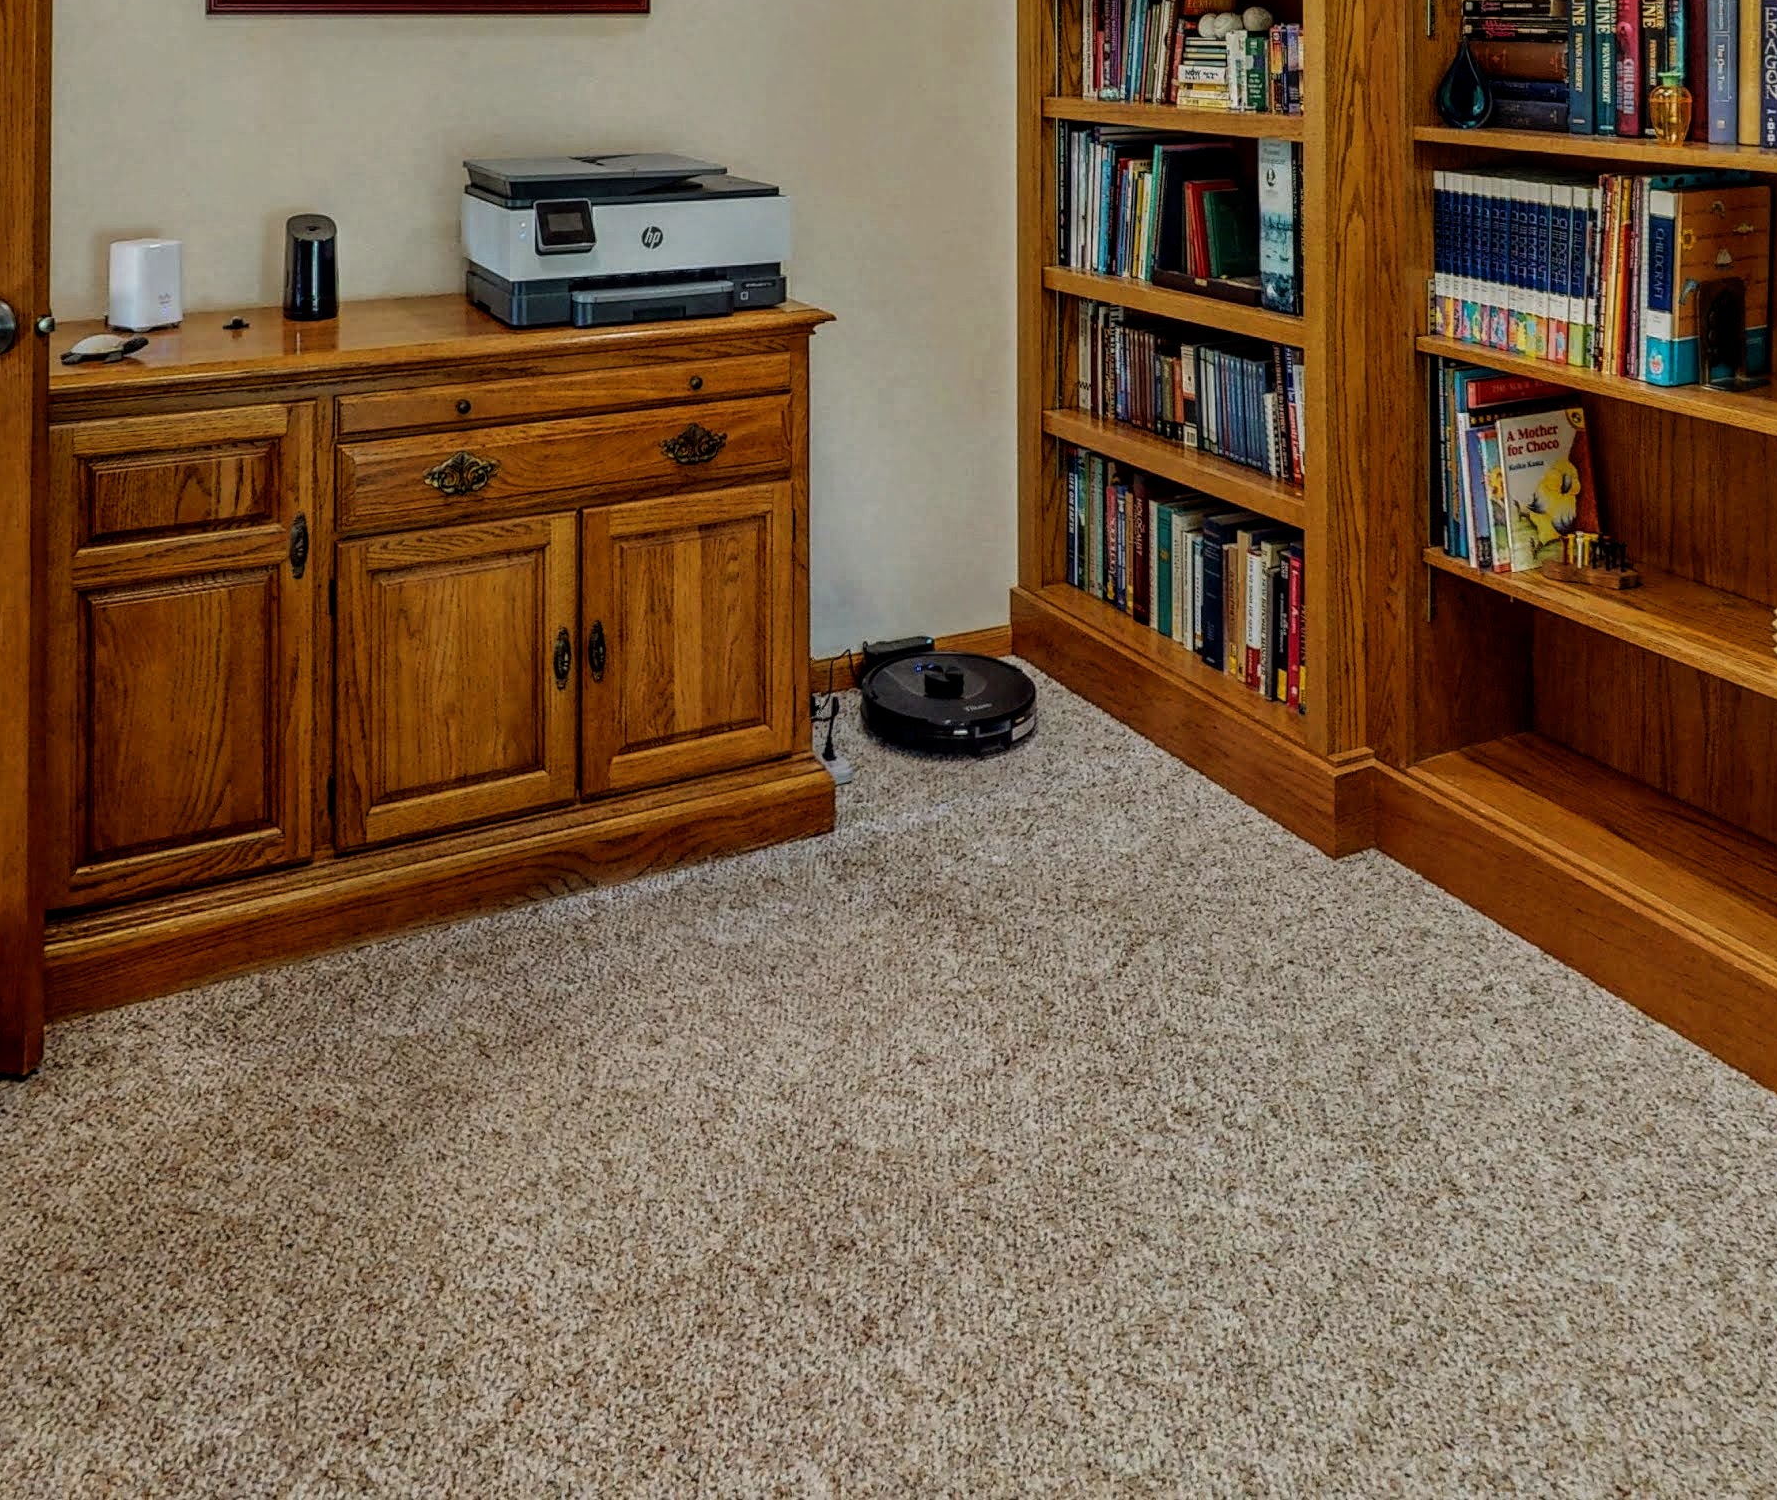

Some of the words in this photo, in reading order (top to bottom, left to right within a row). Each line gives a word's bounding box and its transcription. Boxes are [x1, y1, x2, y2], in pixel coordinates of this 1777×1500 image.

[1574, 57, 1583, 92] HERBERT
[1622, 58, 1635, 114] CHILDREN
[645, 226, 662, 249] hp
[1572, 219, 1582, 288] CHILDCRAFT
[1653, 227, 1665, 300] CHILDCRAFT
[1506, 431, 1515, 442] A
[1517, 425, 1559, 440] Mother
[1507, 445, 1524, 457] for
[1526, 440, 1560, 453] Choco
